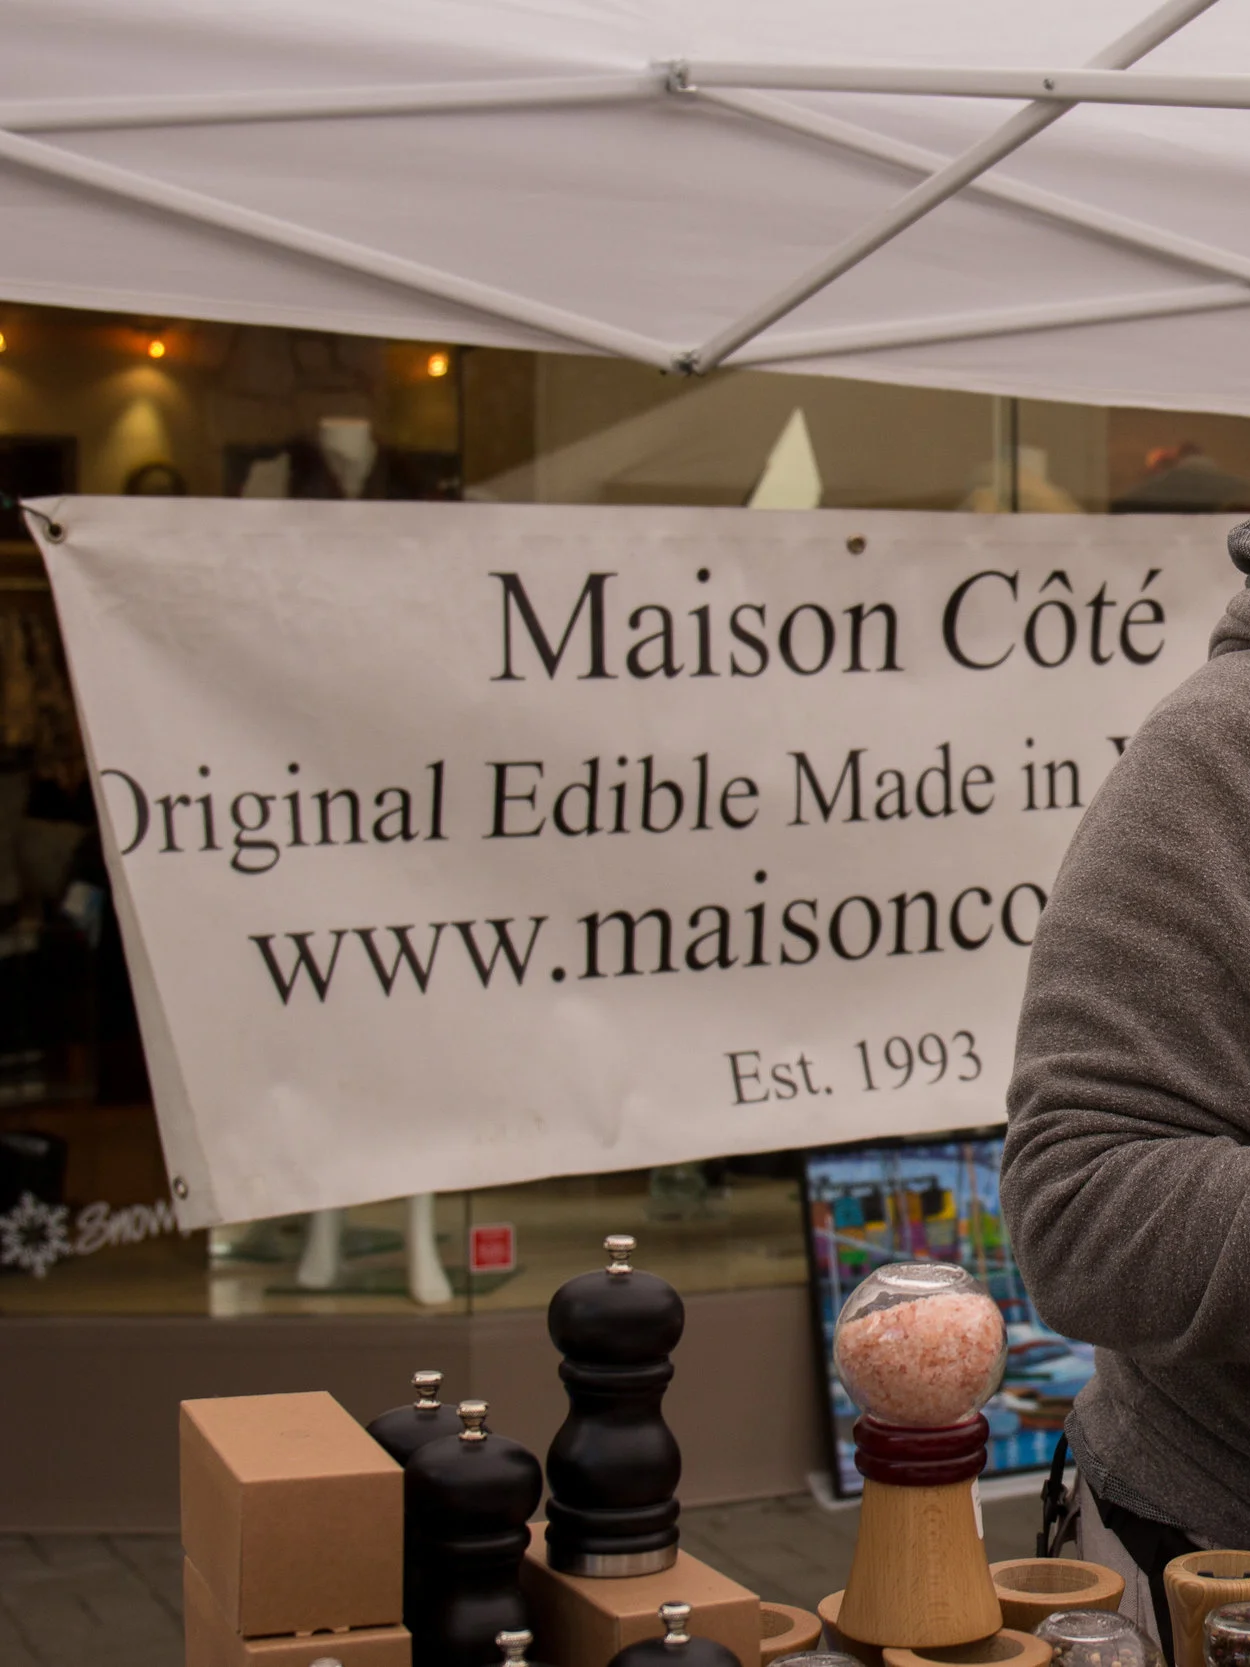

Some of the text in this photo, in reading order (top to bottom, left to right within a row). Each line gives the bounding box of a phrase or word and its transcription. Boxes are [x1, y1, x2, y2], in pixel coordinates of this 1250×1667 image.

[489, 568, 1168, 681] Maison Côté
[483, 754, 759, 839] Edible
[786, 743, 996, 827] Made
[1020, 738, 1087, 812] in
[249, 870, 1049, 1006] www.maisonco
[725, 1031, 984, 1106] Est. 1993
